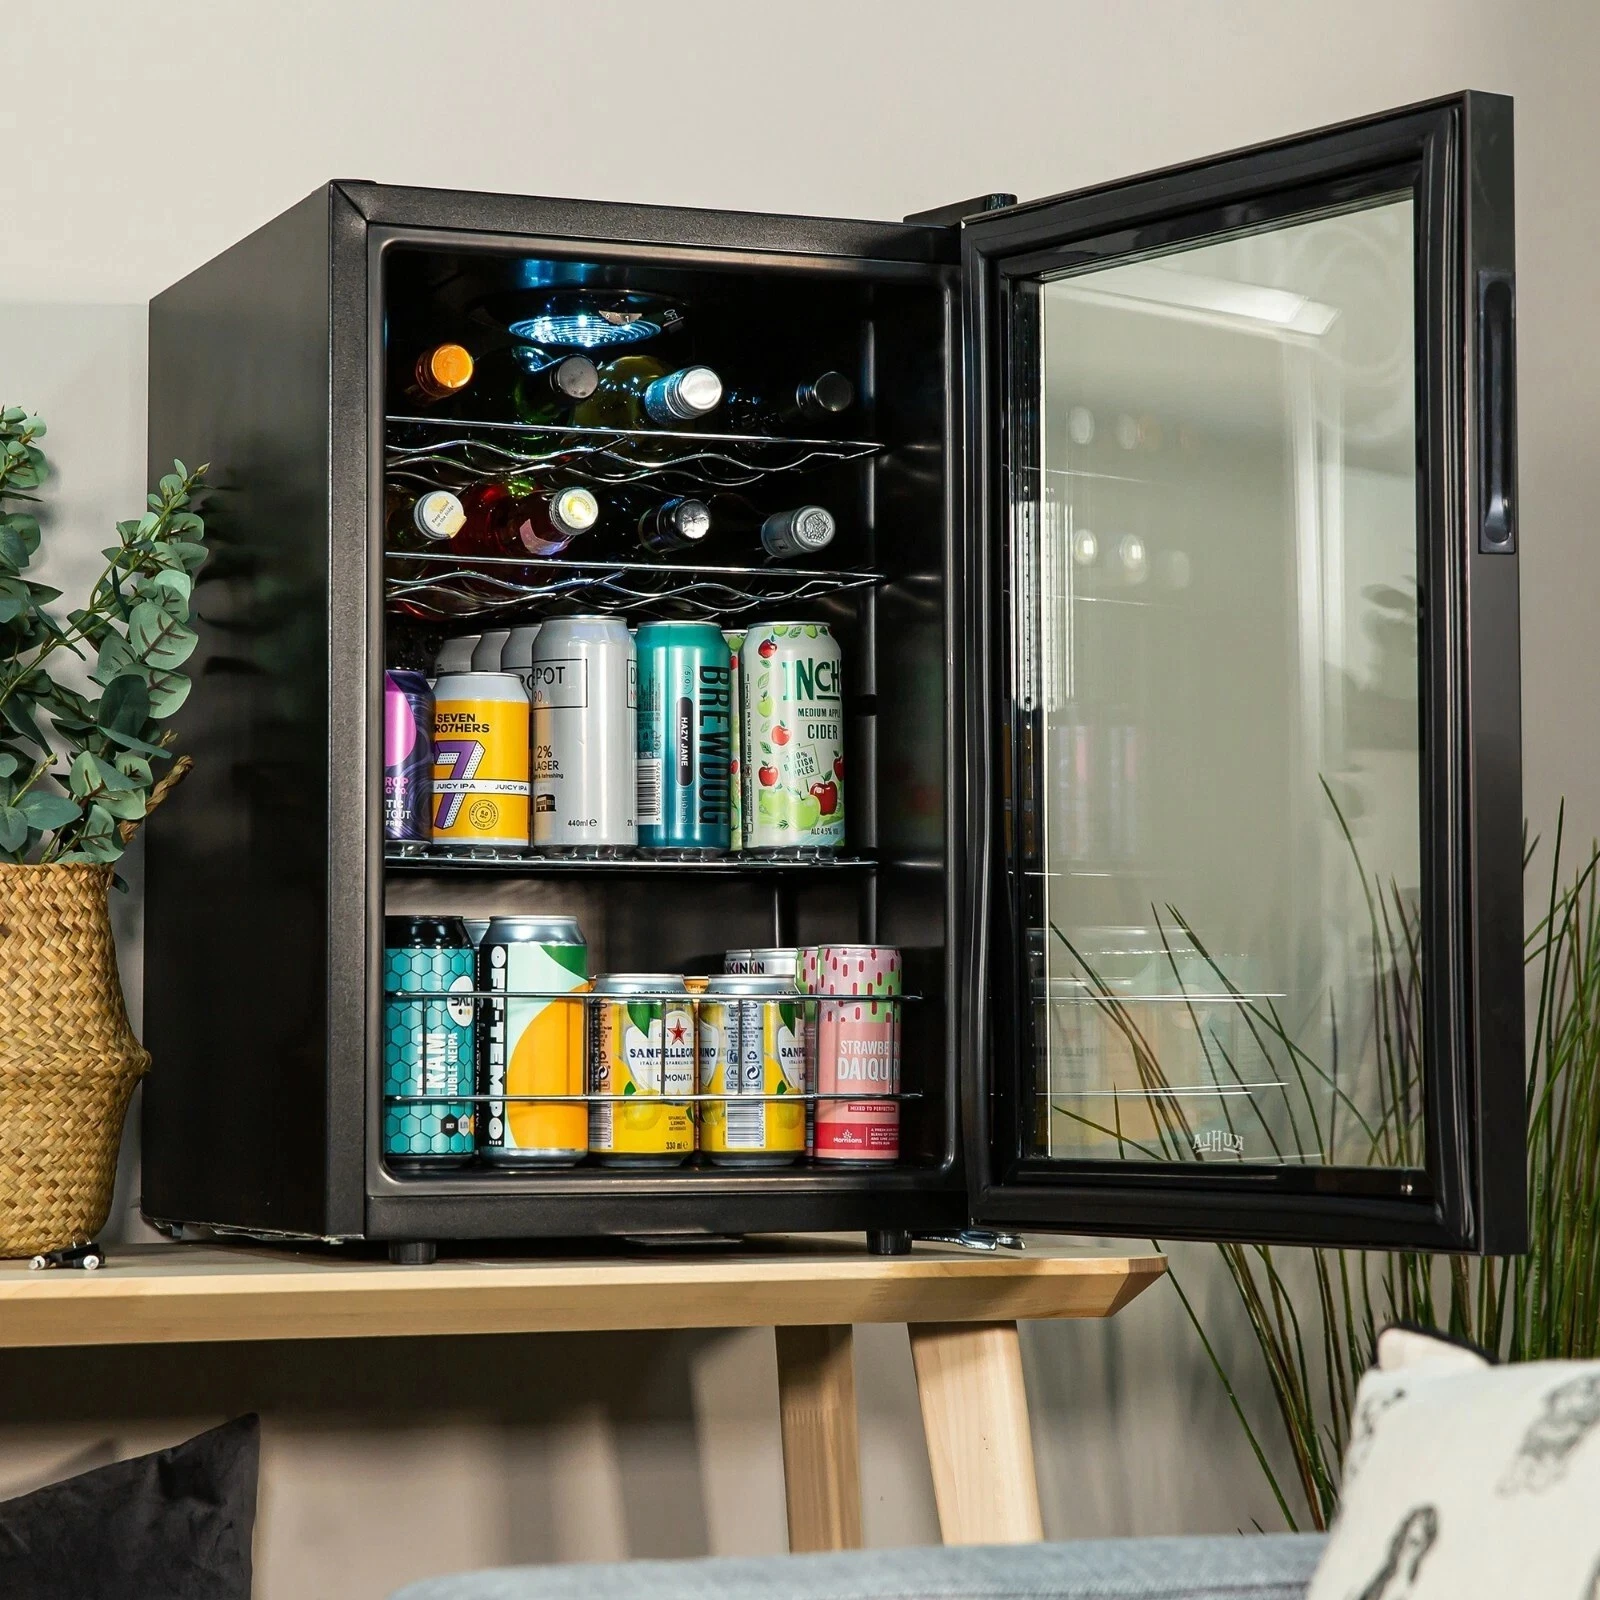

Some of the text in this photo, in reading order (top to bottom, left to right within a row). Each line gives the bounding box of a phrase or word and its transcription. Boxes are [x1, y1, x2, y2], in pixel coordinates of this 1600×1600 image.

[798, 708, 827, 717] MEDIUM
[437, 713, 476, 723] SEVEN
[808, 724, 838, 740] CIDER
[681, 717, 689, 767] HAZY JANE
[699, 666, 729, 824] BREWDOG
[567, 819, 589, 827] 440ml
[811, 827, 820, 835] ALC
[448, 1032, 458, 1062] NEIPA
[656, 1074, 692, 1082] LMONATA
[833, 1136, 863, 1144] Morrisons
[665, 1141, 676, 1150] 330
